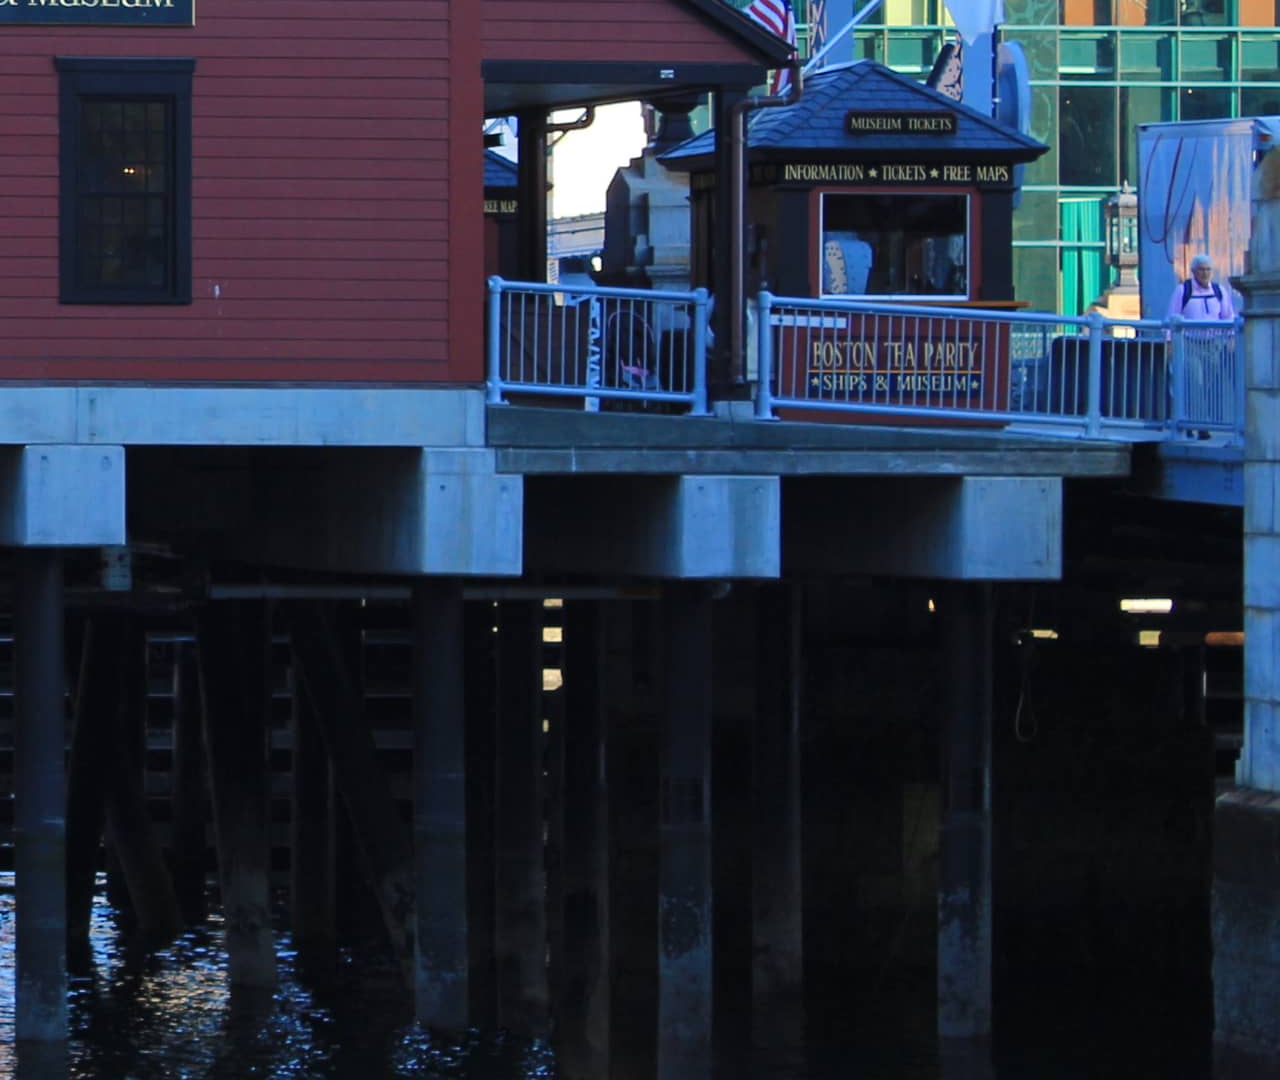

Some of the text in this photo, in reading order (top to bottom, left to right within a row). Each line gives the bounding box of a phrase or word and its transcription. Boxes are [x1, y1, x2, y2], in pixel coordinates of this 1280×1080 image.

[851, 117, 952, 130] MUSEUM TICKETS
[784, 164, 1009, 182] INFORMATION TICKETS FREE MAPS
[483, 199, 518, 213] REE MAP
[924, 342, 979, 368] PARTY
[875, 374, 889, 391] &
[896, 375, 966, 392] MUSEUM
